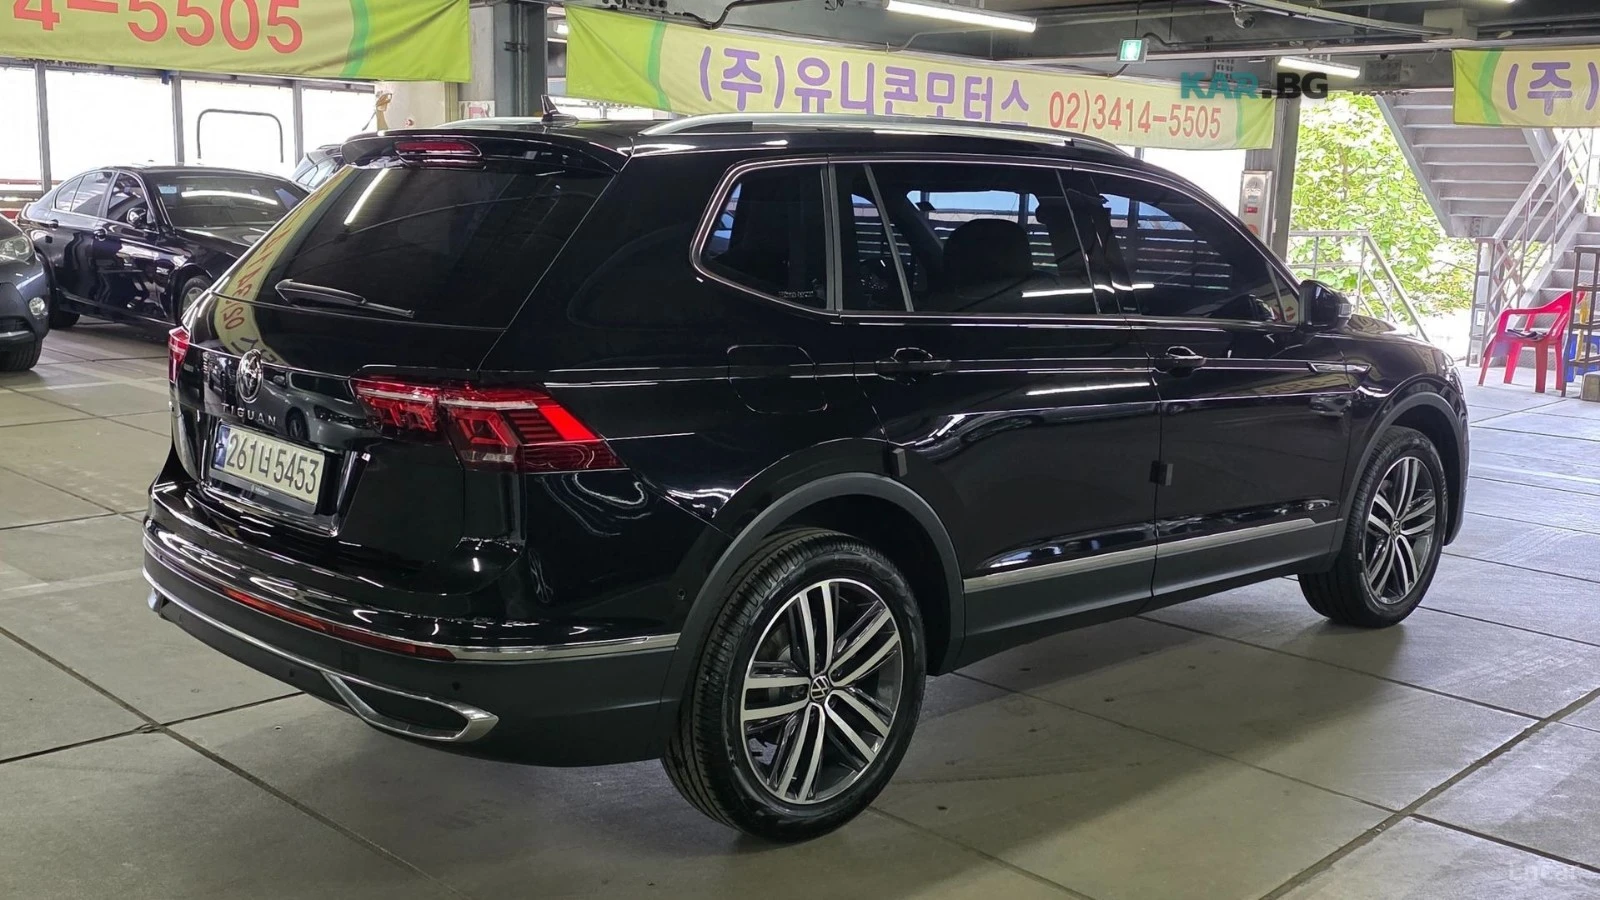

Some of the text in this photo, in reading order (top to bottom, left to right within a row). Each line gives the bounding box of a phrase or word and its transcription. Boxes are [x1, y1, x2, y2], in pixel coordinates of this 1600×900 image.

[1049, 89, 1222, 139] 02)3414-5505
[1506, 62, 1600, 116] (주)
[220, 402, 277, 426] TIGUAN
